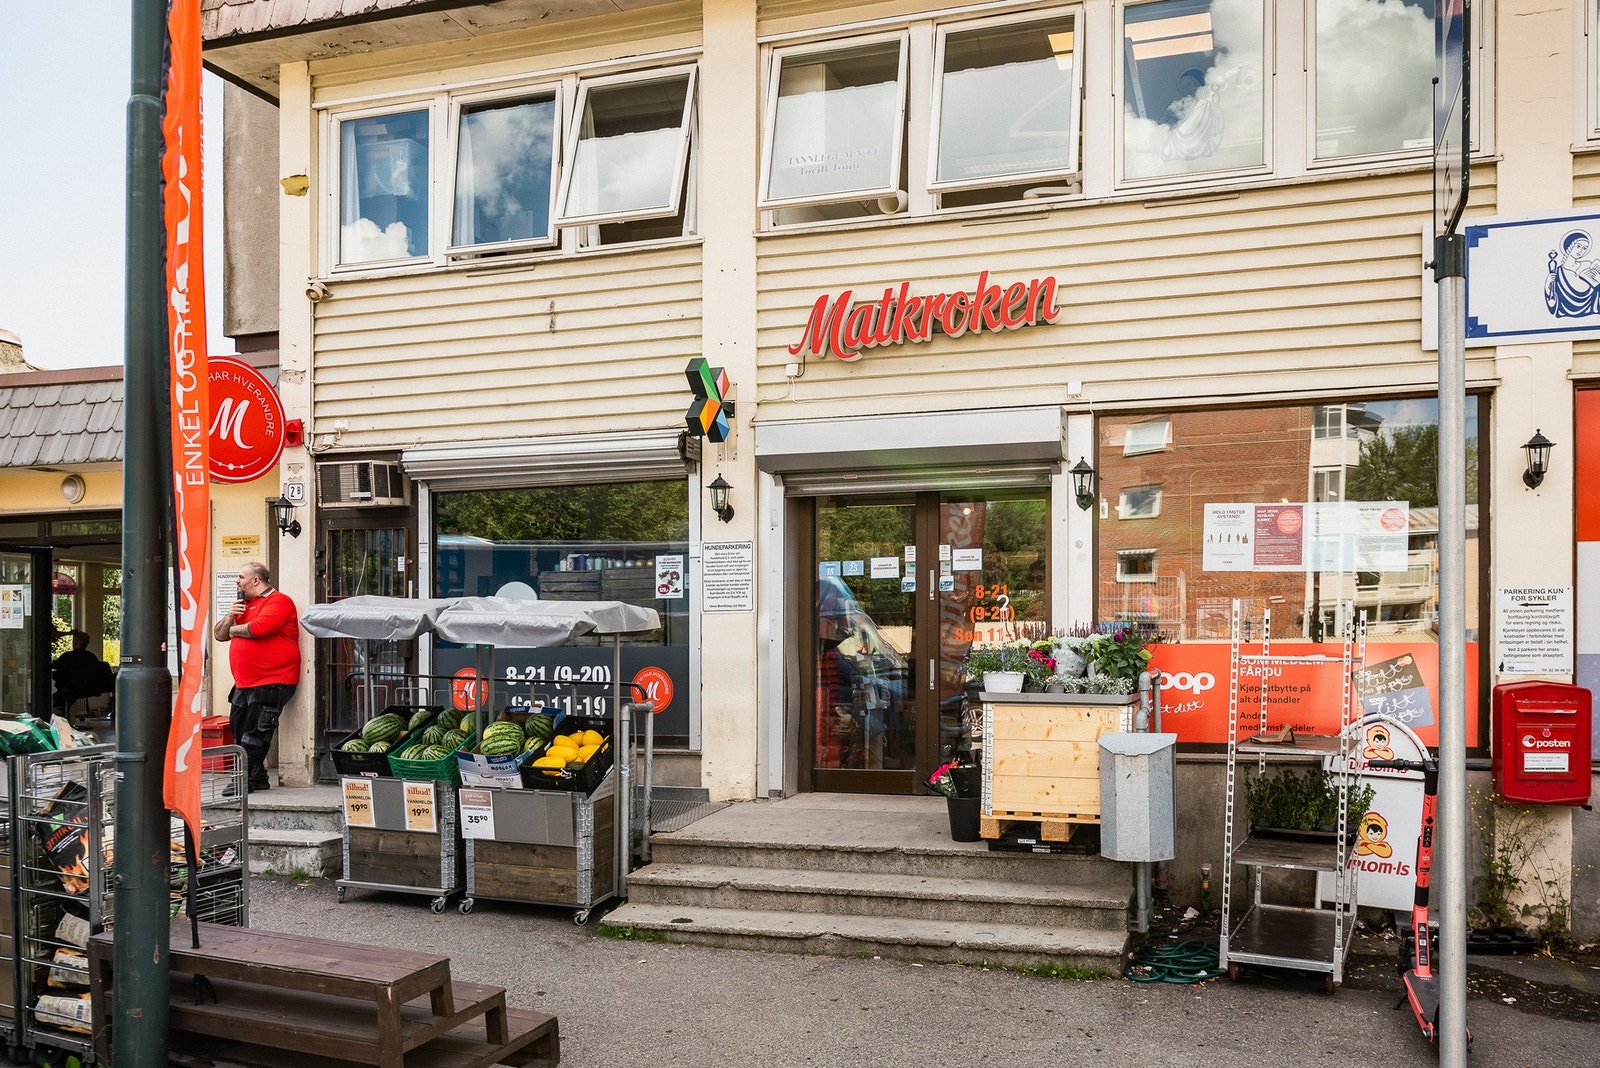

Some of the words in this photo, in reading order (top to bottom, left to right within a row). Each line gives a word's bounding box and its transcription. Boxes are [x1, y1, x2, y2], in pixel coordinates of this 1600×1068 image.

[788, 270, 1062, 361] Matkroken
[208, 371, 230, 382] HAR
[233, 374, 275, 438] HVERANDRE
[181, 399, 205, 486] ENKEL
[704, 543, 751, 551] HUNDEPARKERING
[848, 564, 858, 572] 25
[975, 584, 1008, 599] 8-21
[955, 627, 983, 642] Søn
[505, 665, 546, 687] 8-21
[553, 665, 611, 690] (9-20)
[1240, 665, 1262, 677] FÅR
[1151, 672, 1216, 695] oop
[1300, 684, 1311, 693] på
[551, 695, 606, 716] 11-19
[1536, 739, 1571, 749] posten
[346, 783, 369, 792] tilbud!
[408, 787, 431, 796] tilbud!
